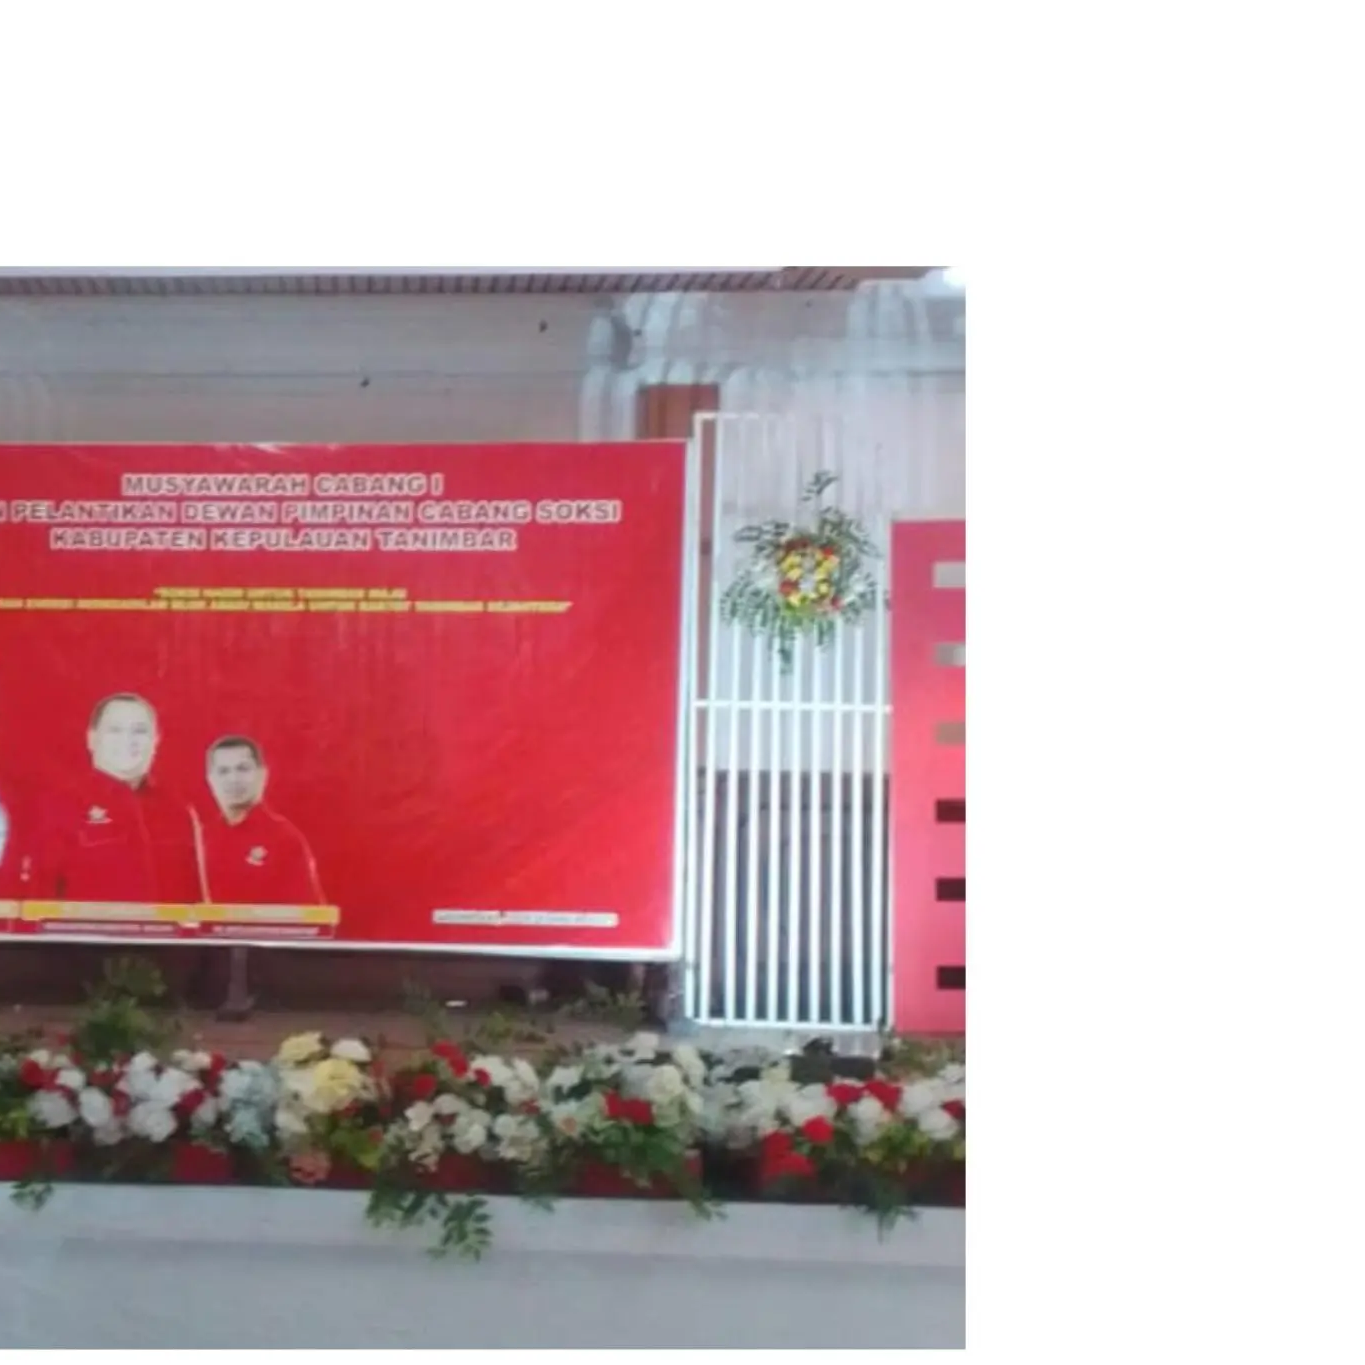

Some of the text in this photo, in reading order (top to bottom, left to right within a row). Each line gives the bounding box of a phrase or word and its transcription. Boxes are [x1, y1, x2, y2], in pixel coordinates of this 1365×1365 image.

[122, 473, 444, 495] MUSYAWARAH CABANG I
[10, 500, 176, 523] PELANTIKAN
[181, 500, 277, 523] DEWAN
[281, 500, 413, 523] PIMPINAN
[419, 500, 531, 523] CABANG
[535, 500, 621, 523] SOKSI
[49, 528, 517, 550] KABUPATEN KEPULAUAN TANIMBAR
